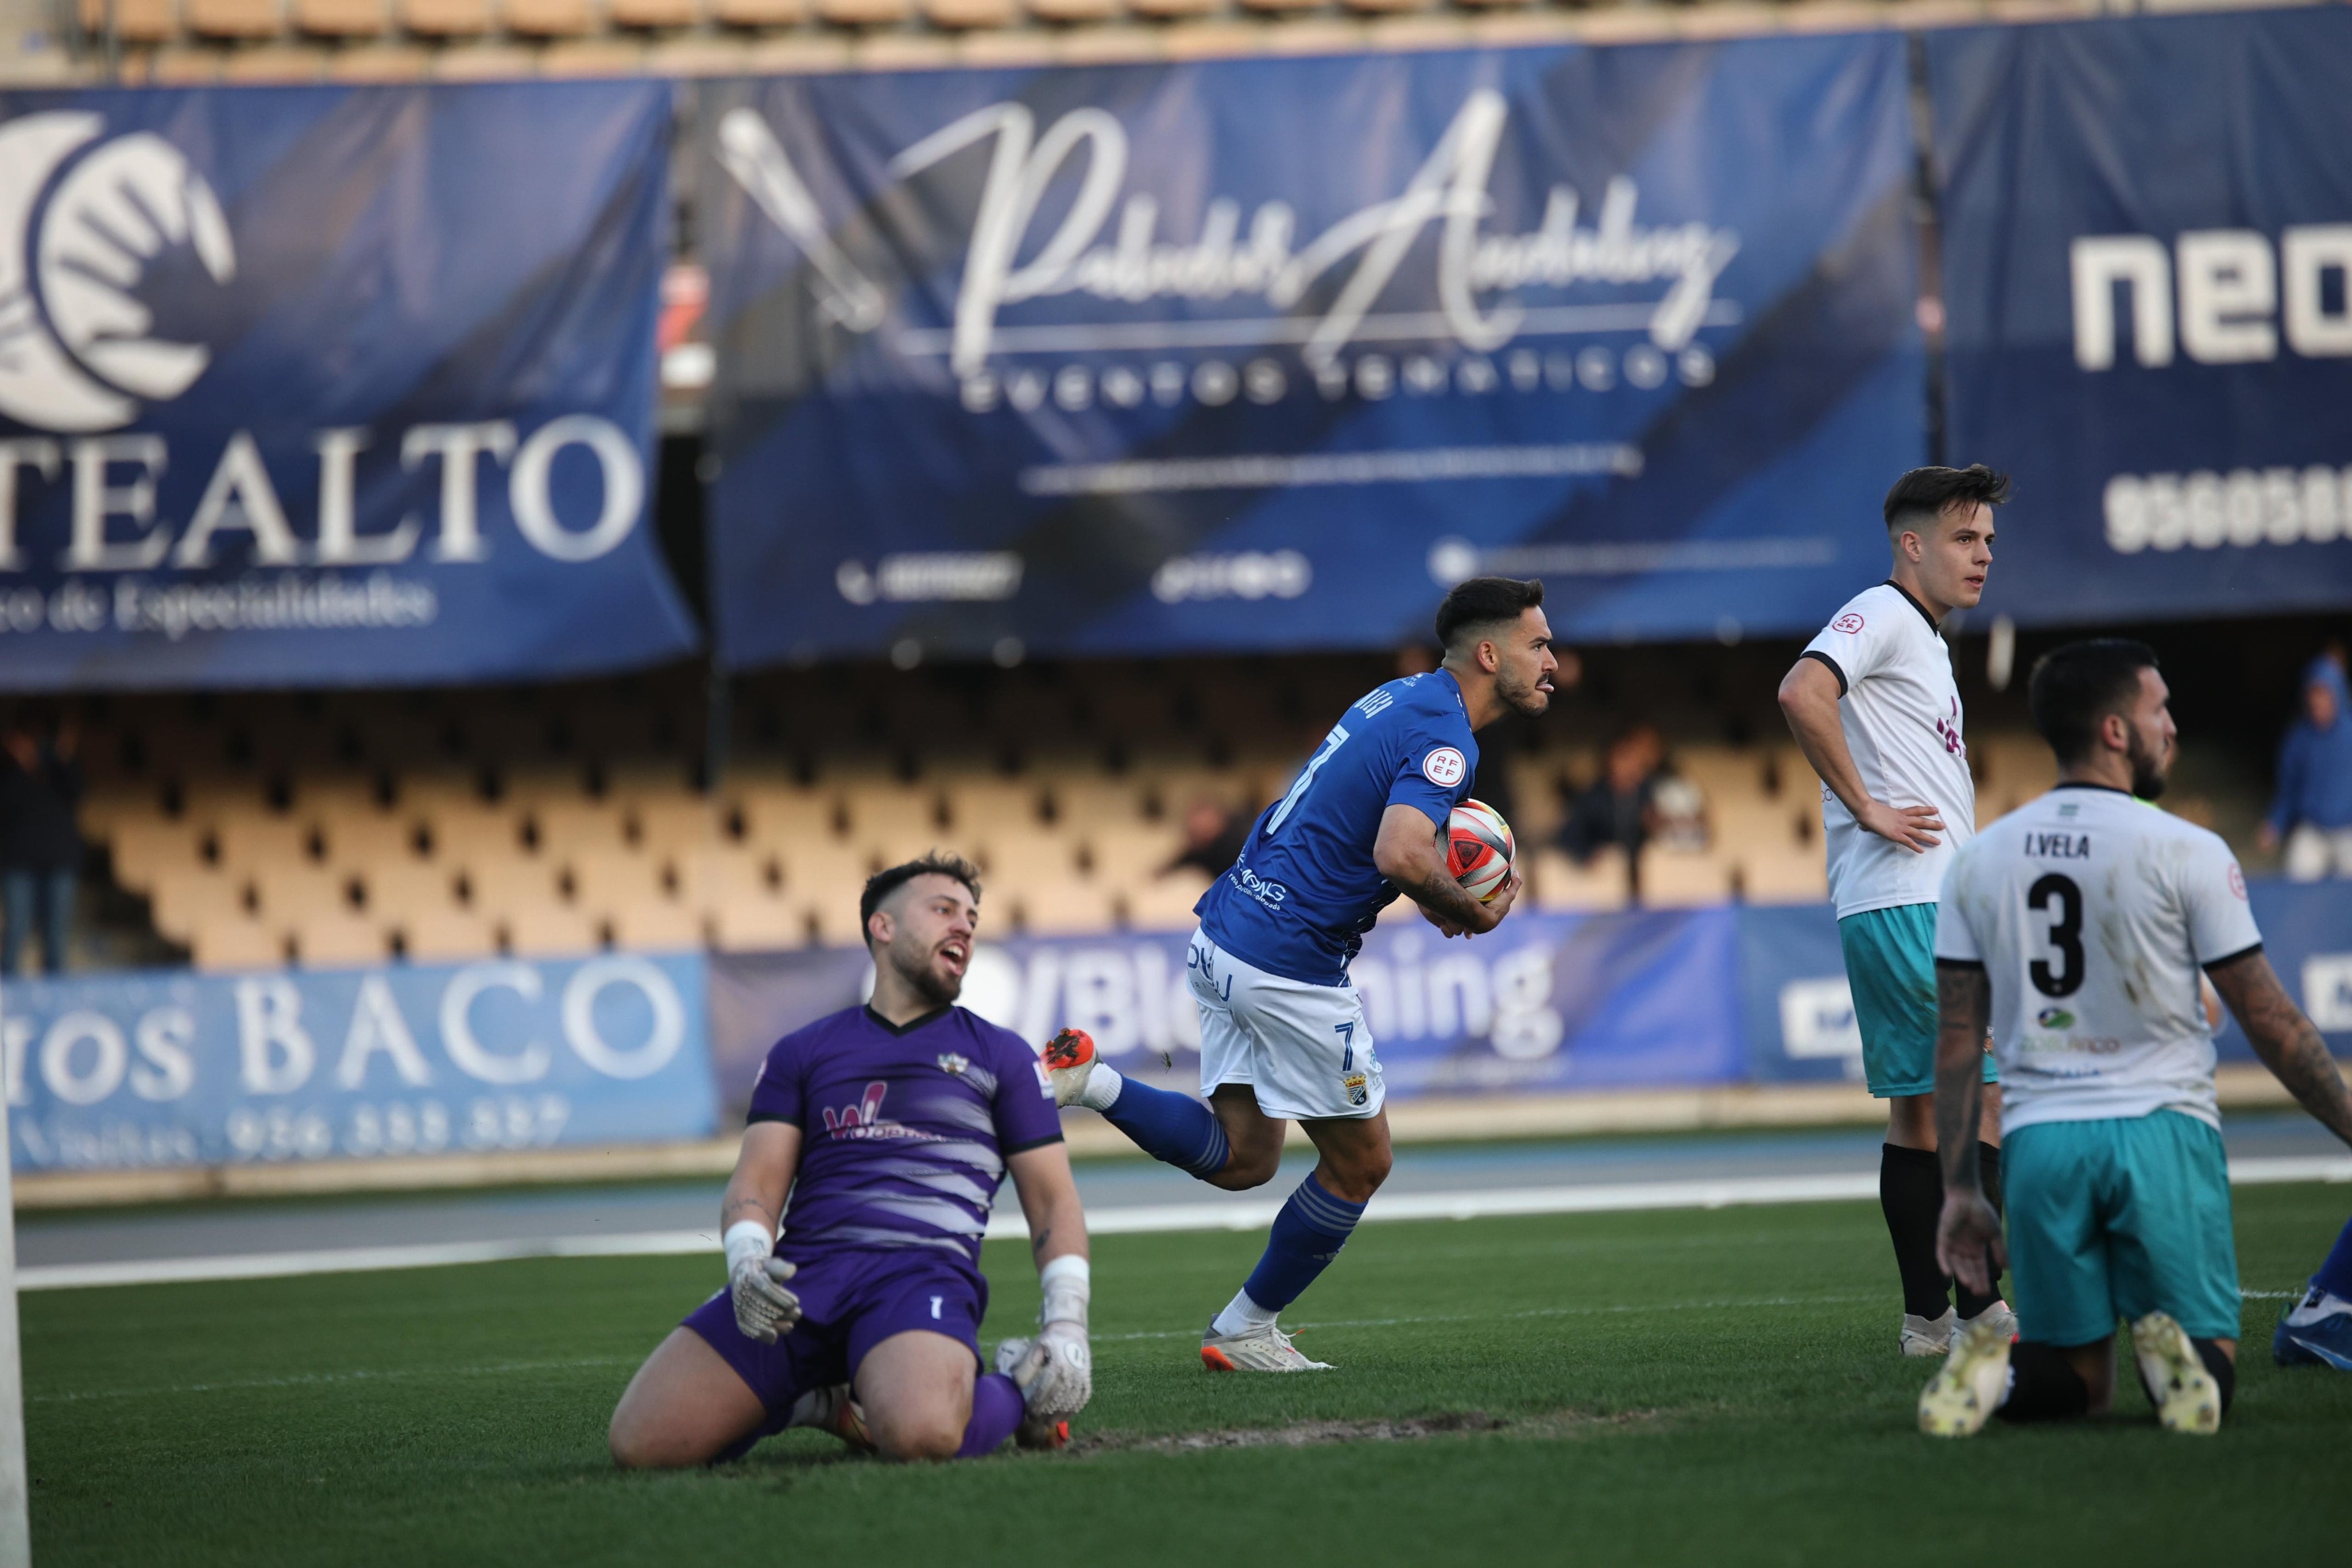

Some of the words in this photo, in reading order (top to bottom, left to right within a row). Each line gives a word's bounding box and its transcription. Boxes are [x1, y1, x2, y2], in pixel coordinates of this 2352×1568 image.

[961, 358, 1287, 412] EVENTOS
[2102, 465, 2352, 553] 956058
[1265, 723, 1350, 835] 7
[2028, 872, 2086, 998] 3
[235, 953, 687, 1095] BACO
[1334, 1021, 1354, 1071] 7
[225, 1104, 334, 1162] 956
